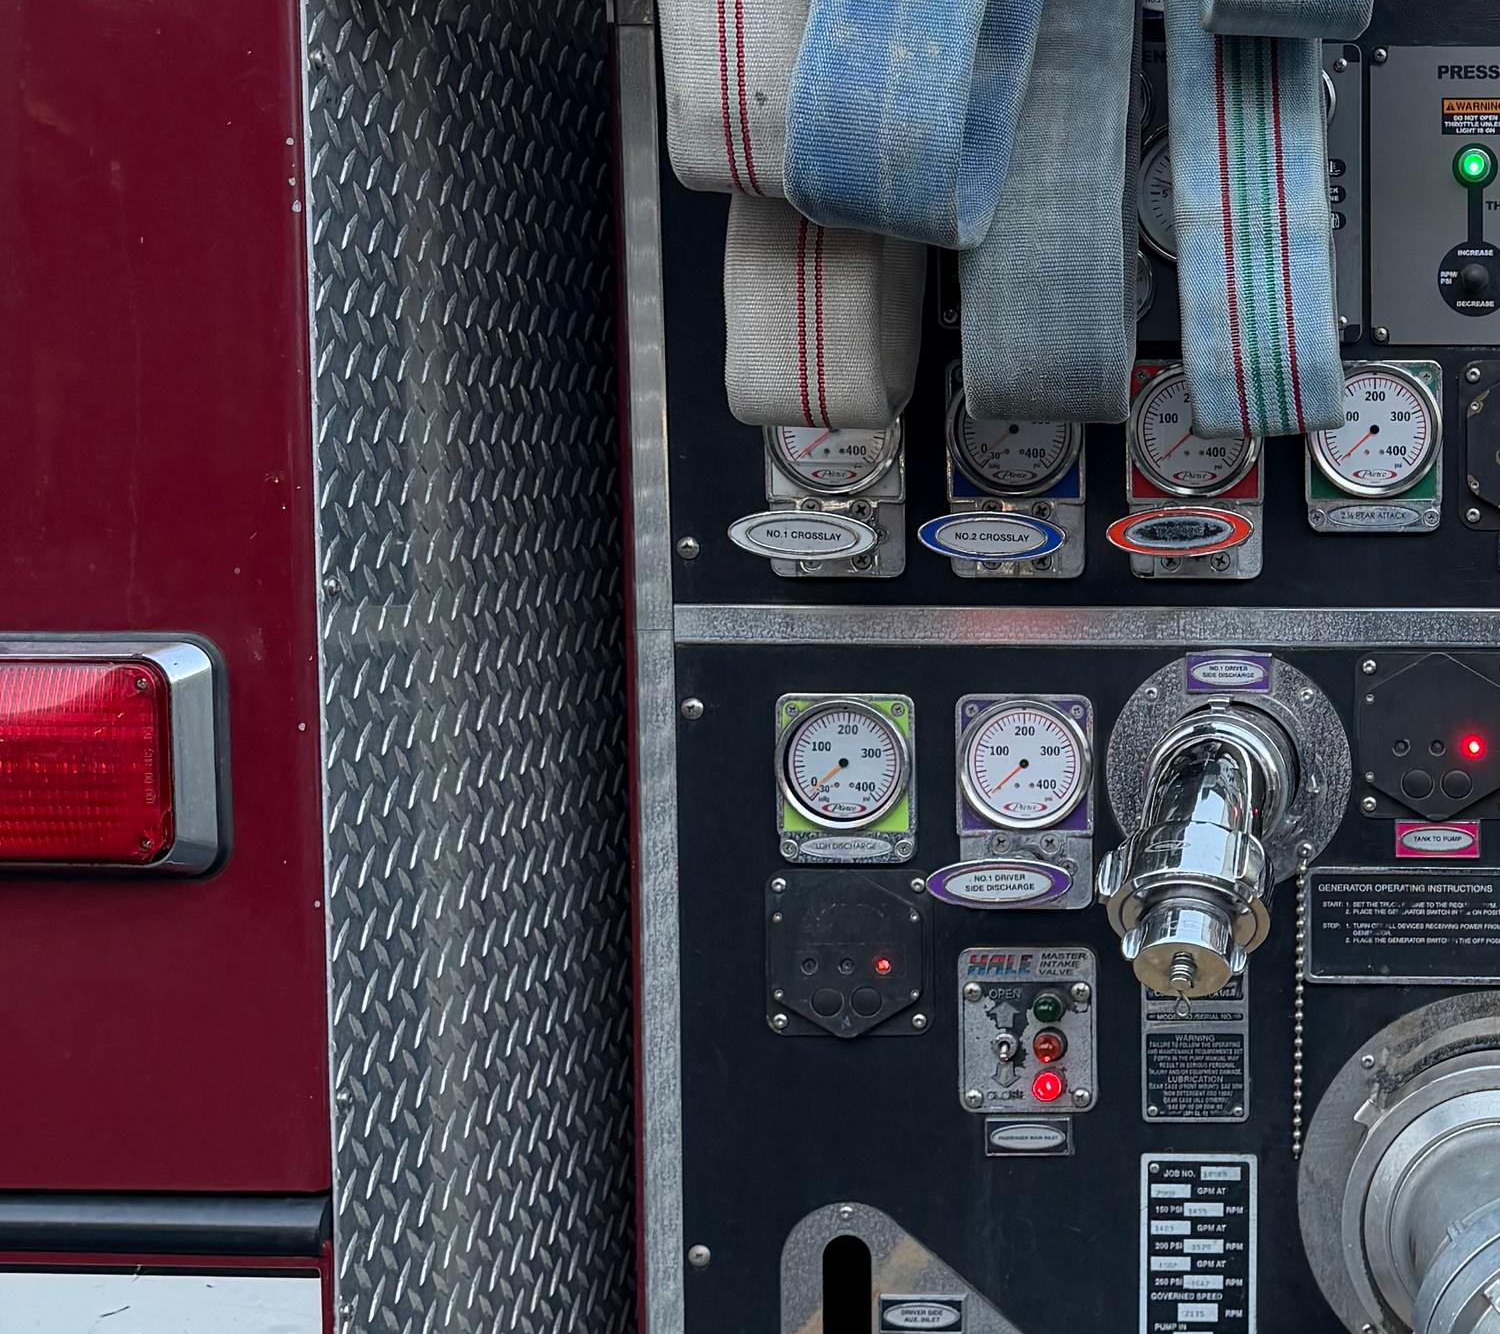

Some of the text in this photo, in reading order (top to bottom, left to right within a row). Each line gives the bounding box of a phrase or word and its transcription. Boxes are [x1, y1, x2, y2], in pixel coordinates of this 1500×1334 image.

[1365, 391, 1385, 401] 200
[1160, 413, 1178, 423] 100
[1390, 412, 1410, 421] 300
[846, 446, 867, 456] 400
[1025, 448, 1045, 458] 400
[1206, 447, 1225, 457] 400
[1386, 446, 1406, 456] 400
[766, 529, 841, 541] NO.1 CROSSLAY
[955, 532, 1030, 542] NO.2 CROSSLAY
[838, 725, 858, 734] 200
[1015, 726, 1035, 736] 200
[812, 741, 831, 751] 100
[990, 746, 1009, 756] 100
[1040, 746, 1060, 756] 300
[861, 749, 881, 758] 300
[855, 782, 875, 791] 400
[1036, 779, 1057, 789] 400
[987, 883, 1035, 891] DISCHARGE
[1318, 884, 1492, 893] GENERATOR OPERATING INSTRUCTIONS
[968, 955, 1033, 975] HALE
[989, 989, 1021, 998] OPEN
[1151, 1292, 1194, 1300] GOVERNED
